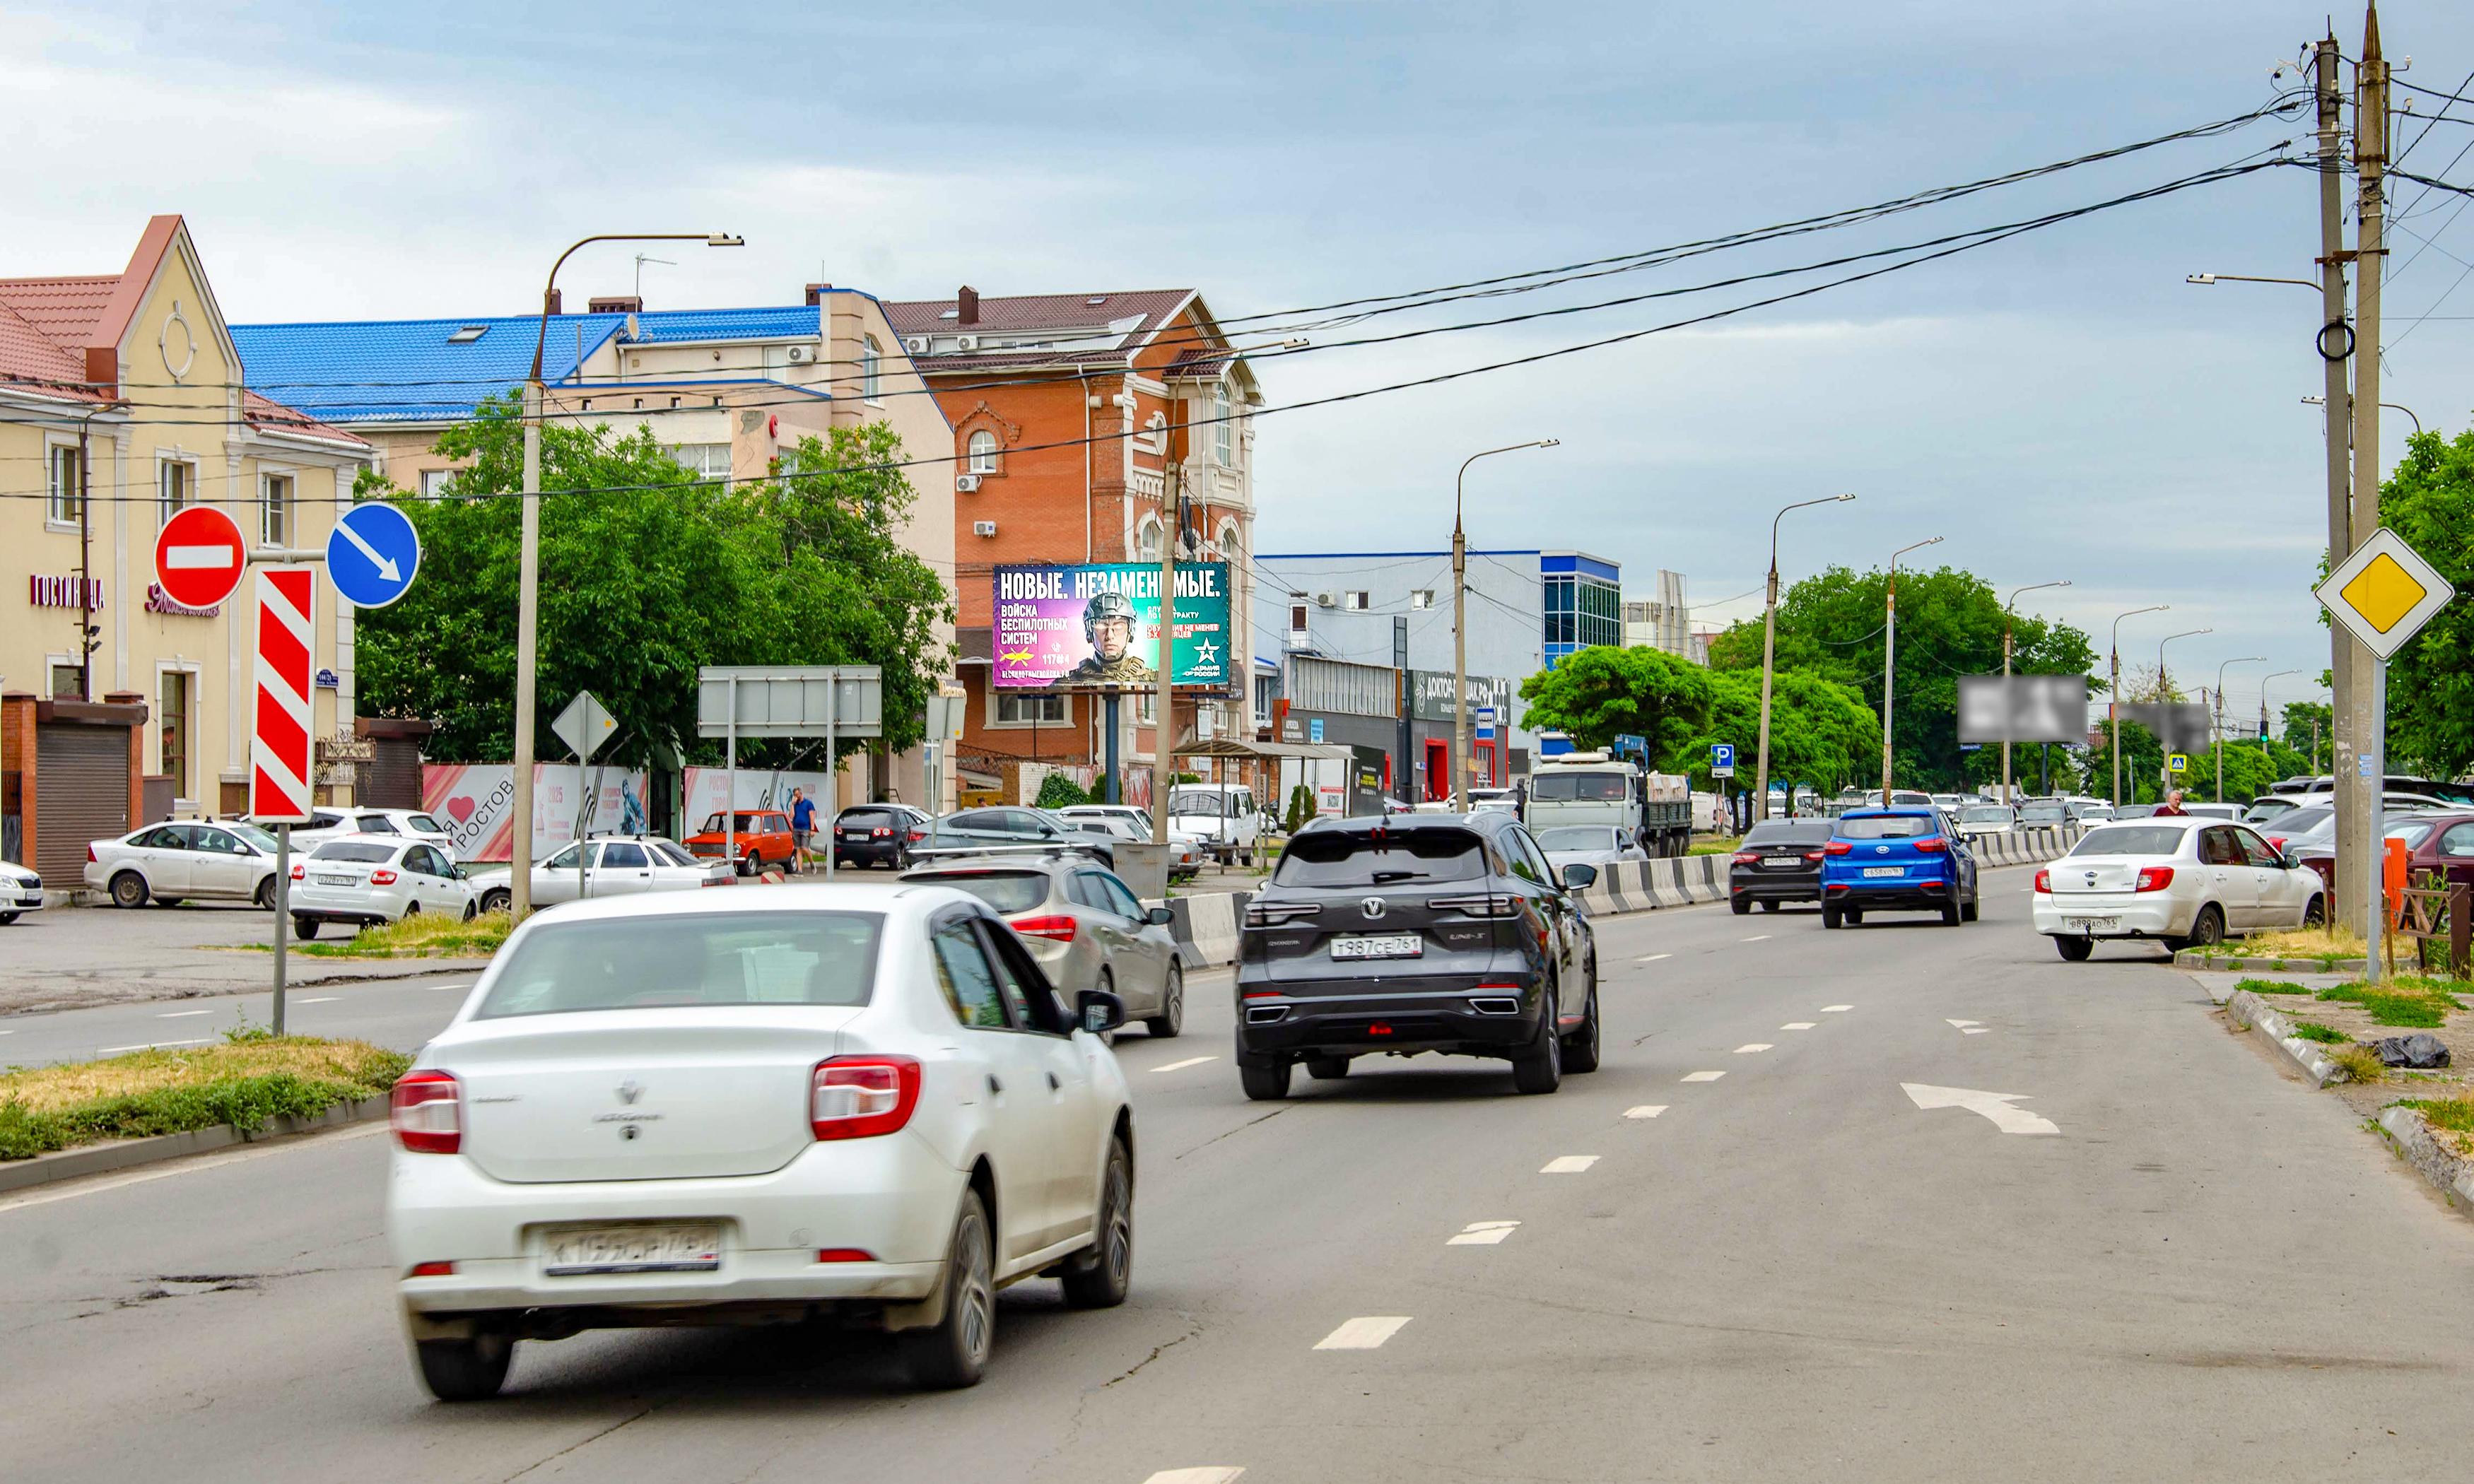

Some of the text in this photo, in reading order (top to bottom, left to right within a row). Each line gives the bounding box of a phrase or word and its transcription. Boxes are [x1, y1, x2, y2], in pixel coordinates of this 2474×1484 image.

[1000, 570, 1221, 600] НОВЫЕ. НЕЗАМЕНМЫЕ.
[31, 575, 105, 613] ГОСТИНЦА
[1001, 603, 1038, 618] ВОЙСКА
[1001, 618, 1068, 631] БЕСПИЛОТНЫХ
[1001, 632, 1038, 644] СИСТЕМ
[709, 775, 731, 793] РОСТО
[548, 786, 563, 804] 2025
[456, 780, 514, 849] РОСТОВ
[443, 820, 459, 837] Я
[1336, 938, 1418, 955] Т987СЕ 761
